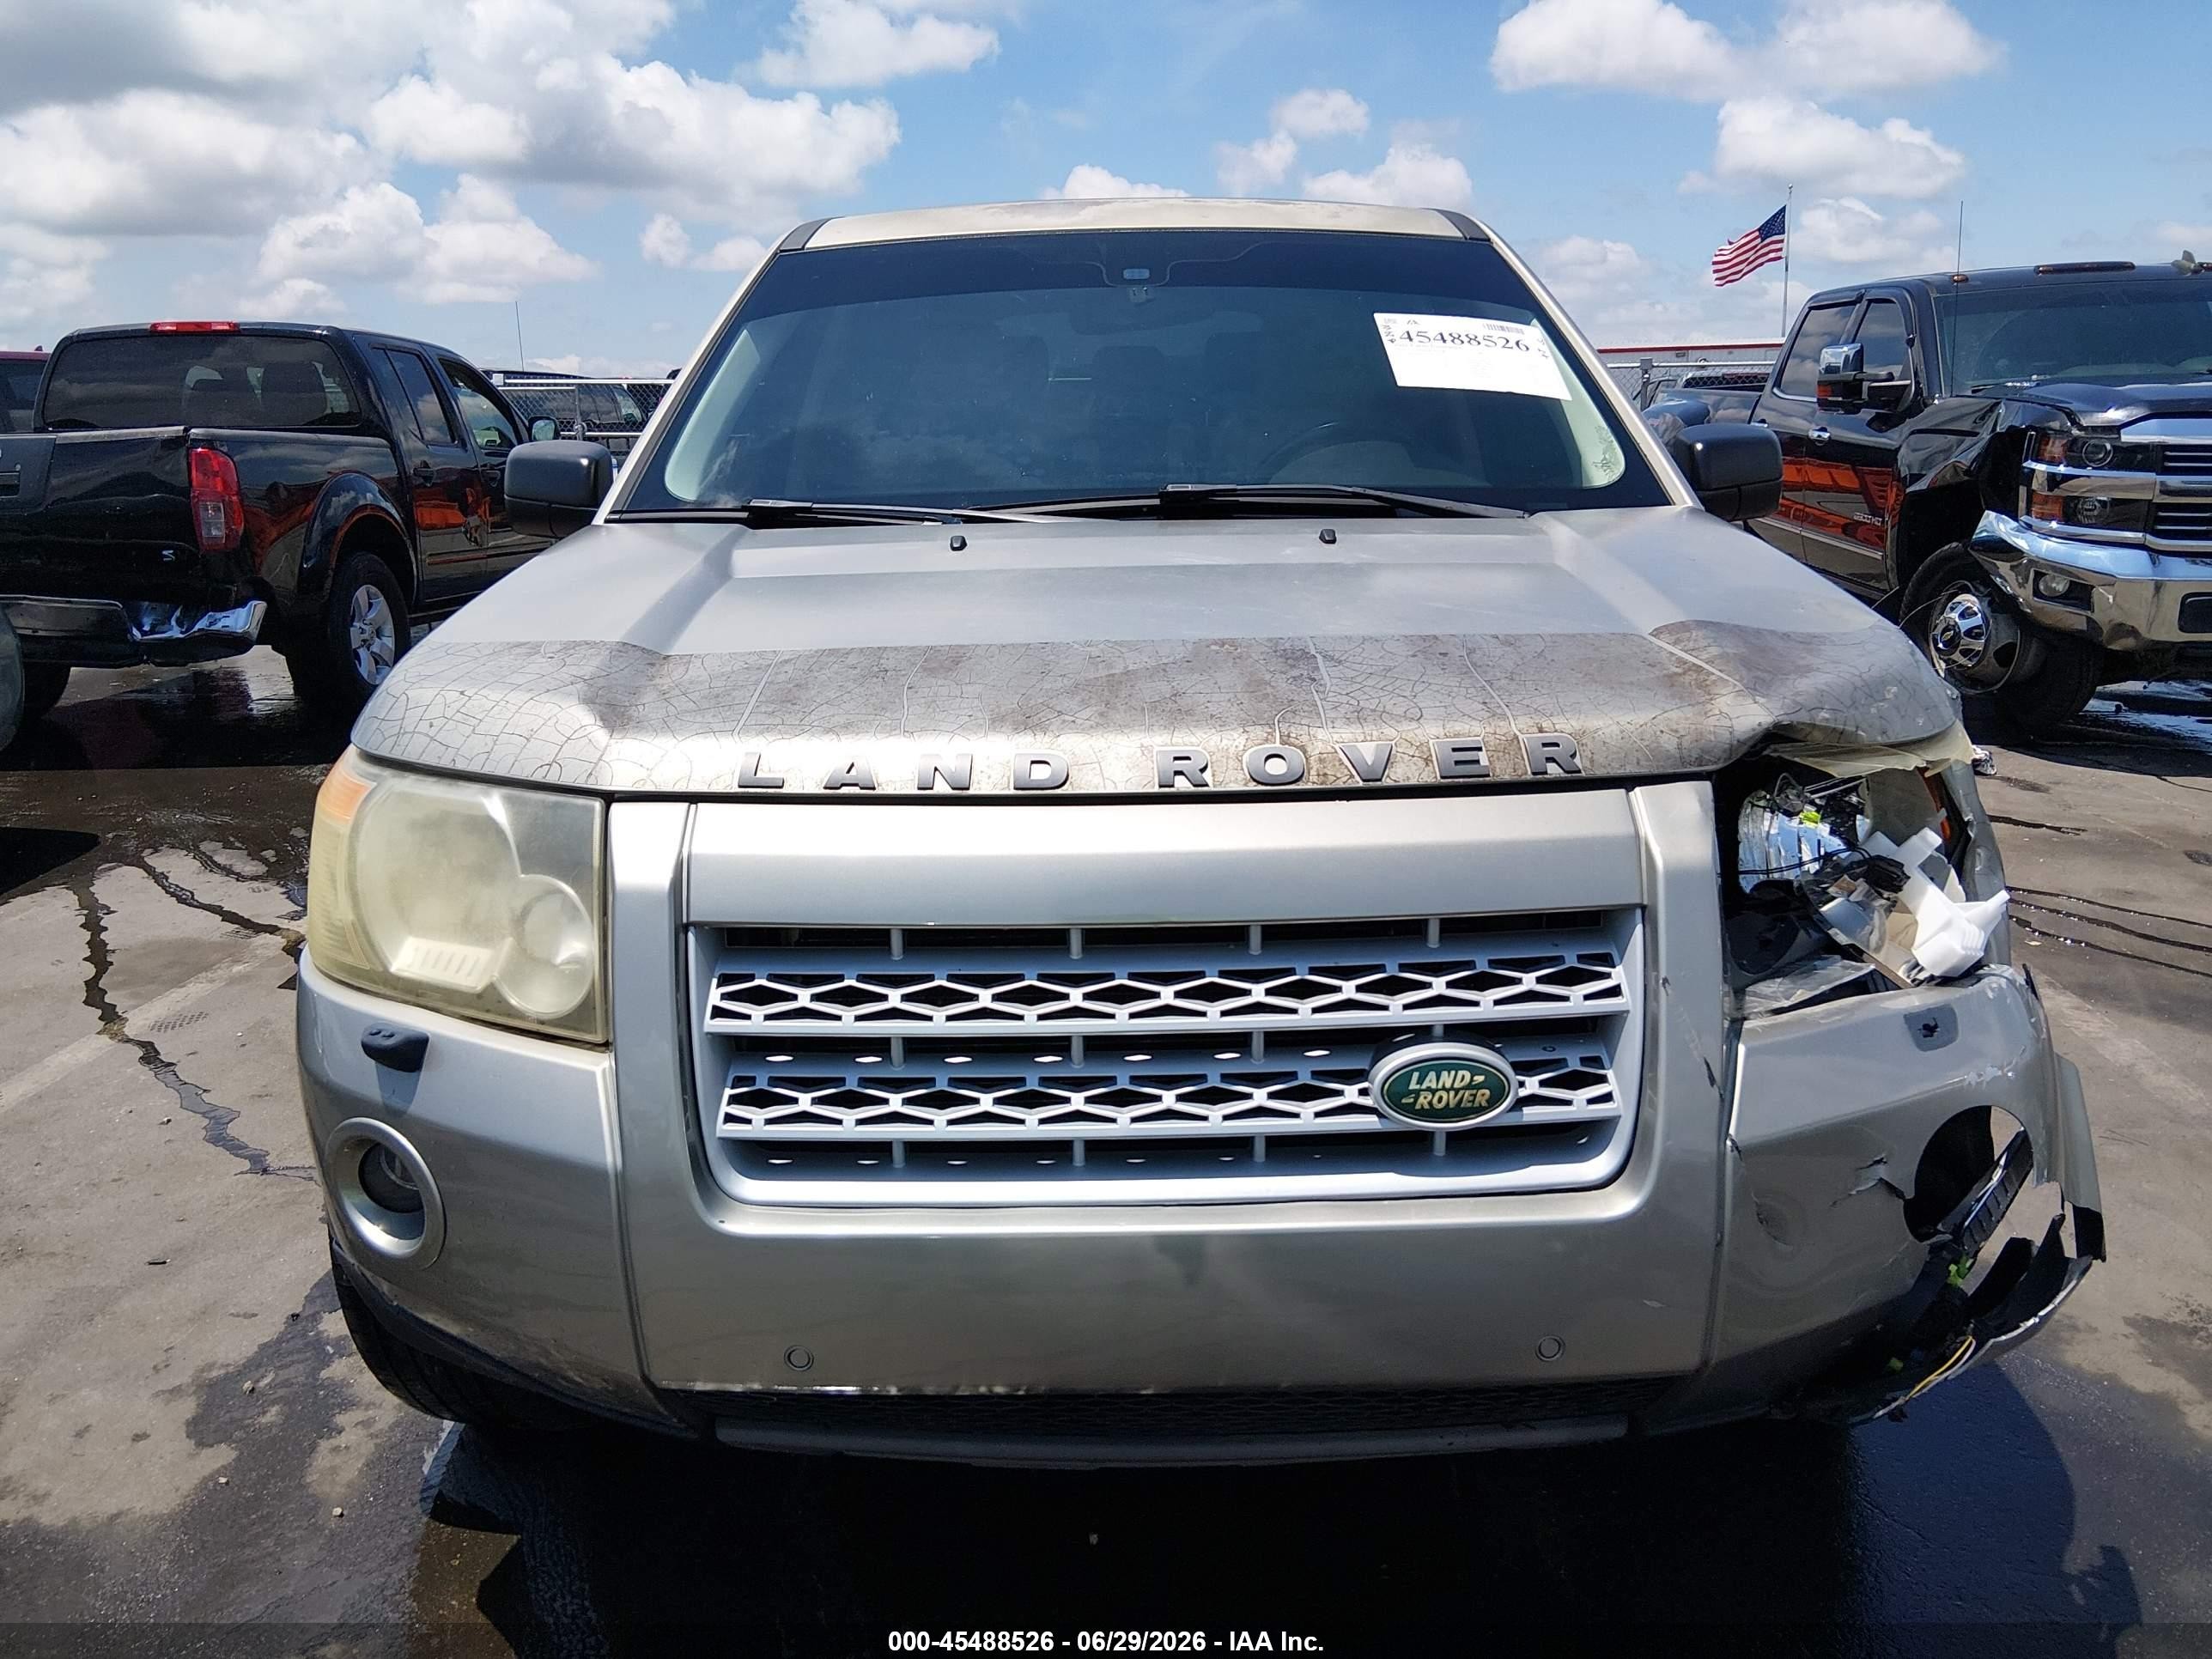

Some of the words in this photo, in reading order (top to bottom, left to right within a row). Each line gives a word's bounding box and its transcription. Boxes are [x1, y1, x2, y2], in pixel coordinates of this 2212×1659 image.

[1400, 330, 1530, 352] 45488526
[738, 751, 1069, 791] LAND
[1157, 735, 1582, 789] ROVER
